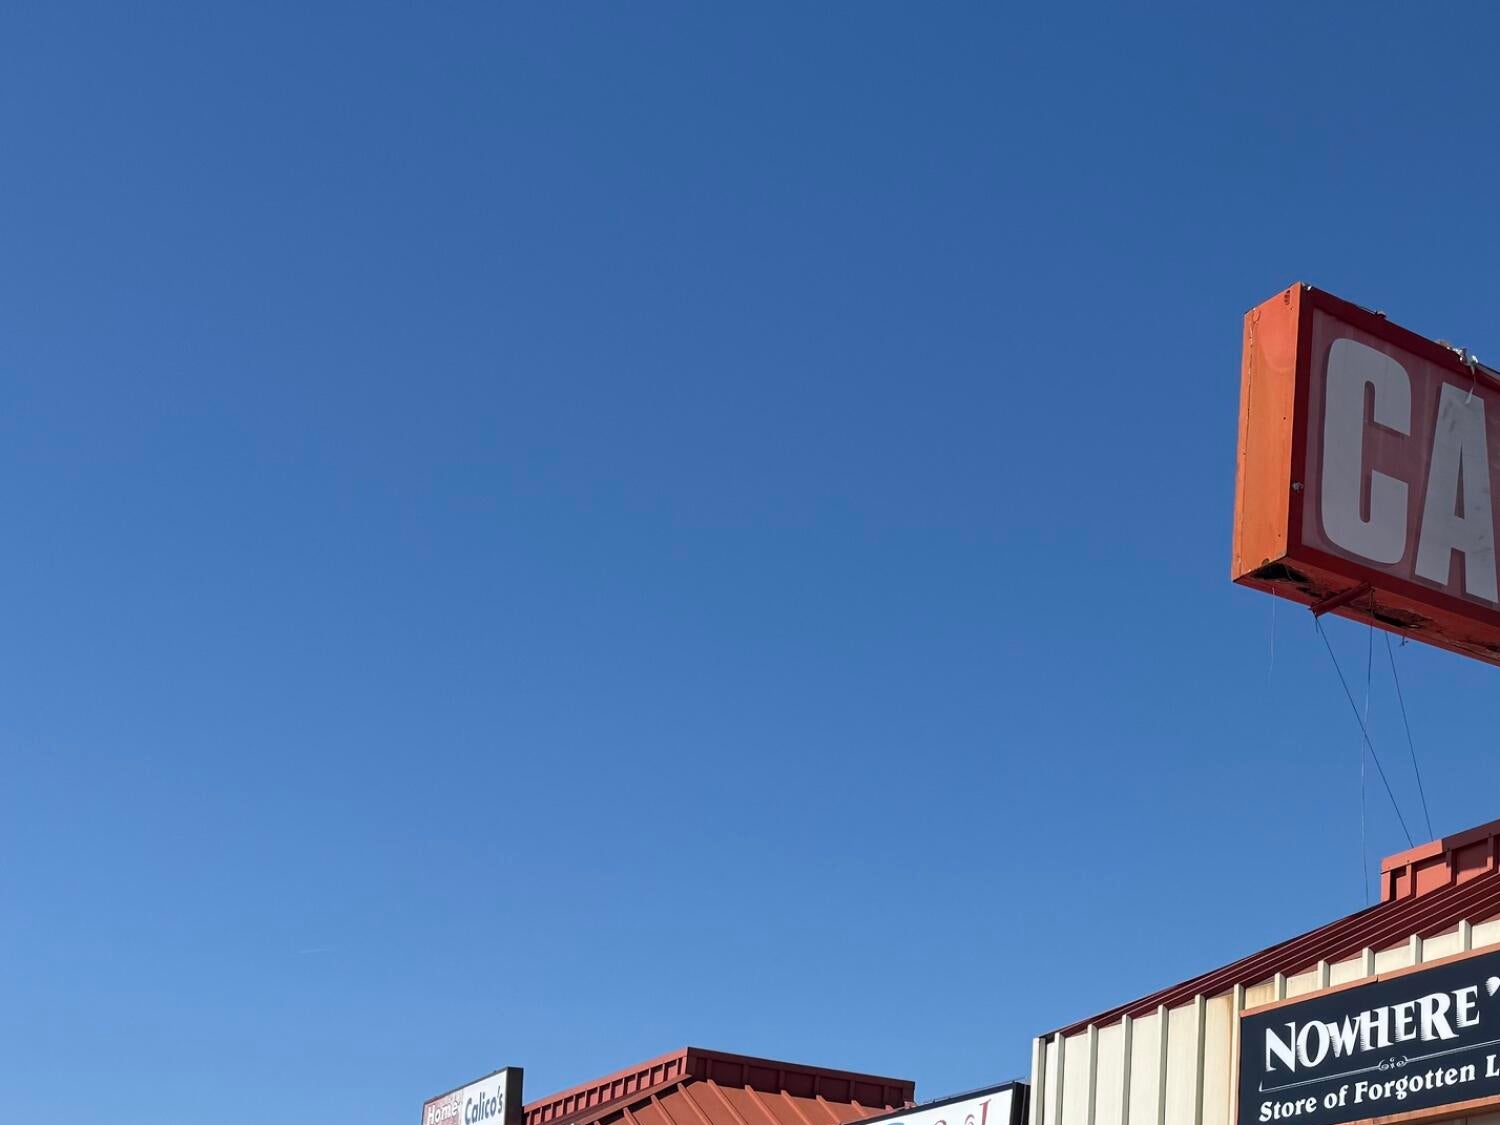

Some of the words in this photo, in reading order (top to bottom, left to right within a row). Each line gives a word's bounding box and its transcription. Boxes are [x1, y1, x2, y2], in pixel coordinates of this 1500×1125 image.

[427, 1101, 458, 1125] Home
[464, 1085, 504, 1125] Calico's
[1258, 1093, 1318, 1122] Store
[1323, 1083, 1348, 1111] of
[1353, 1064, 1476, 1100] Forgotten
